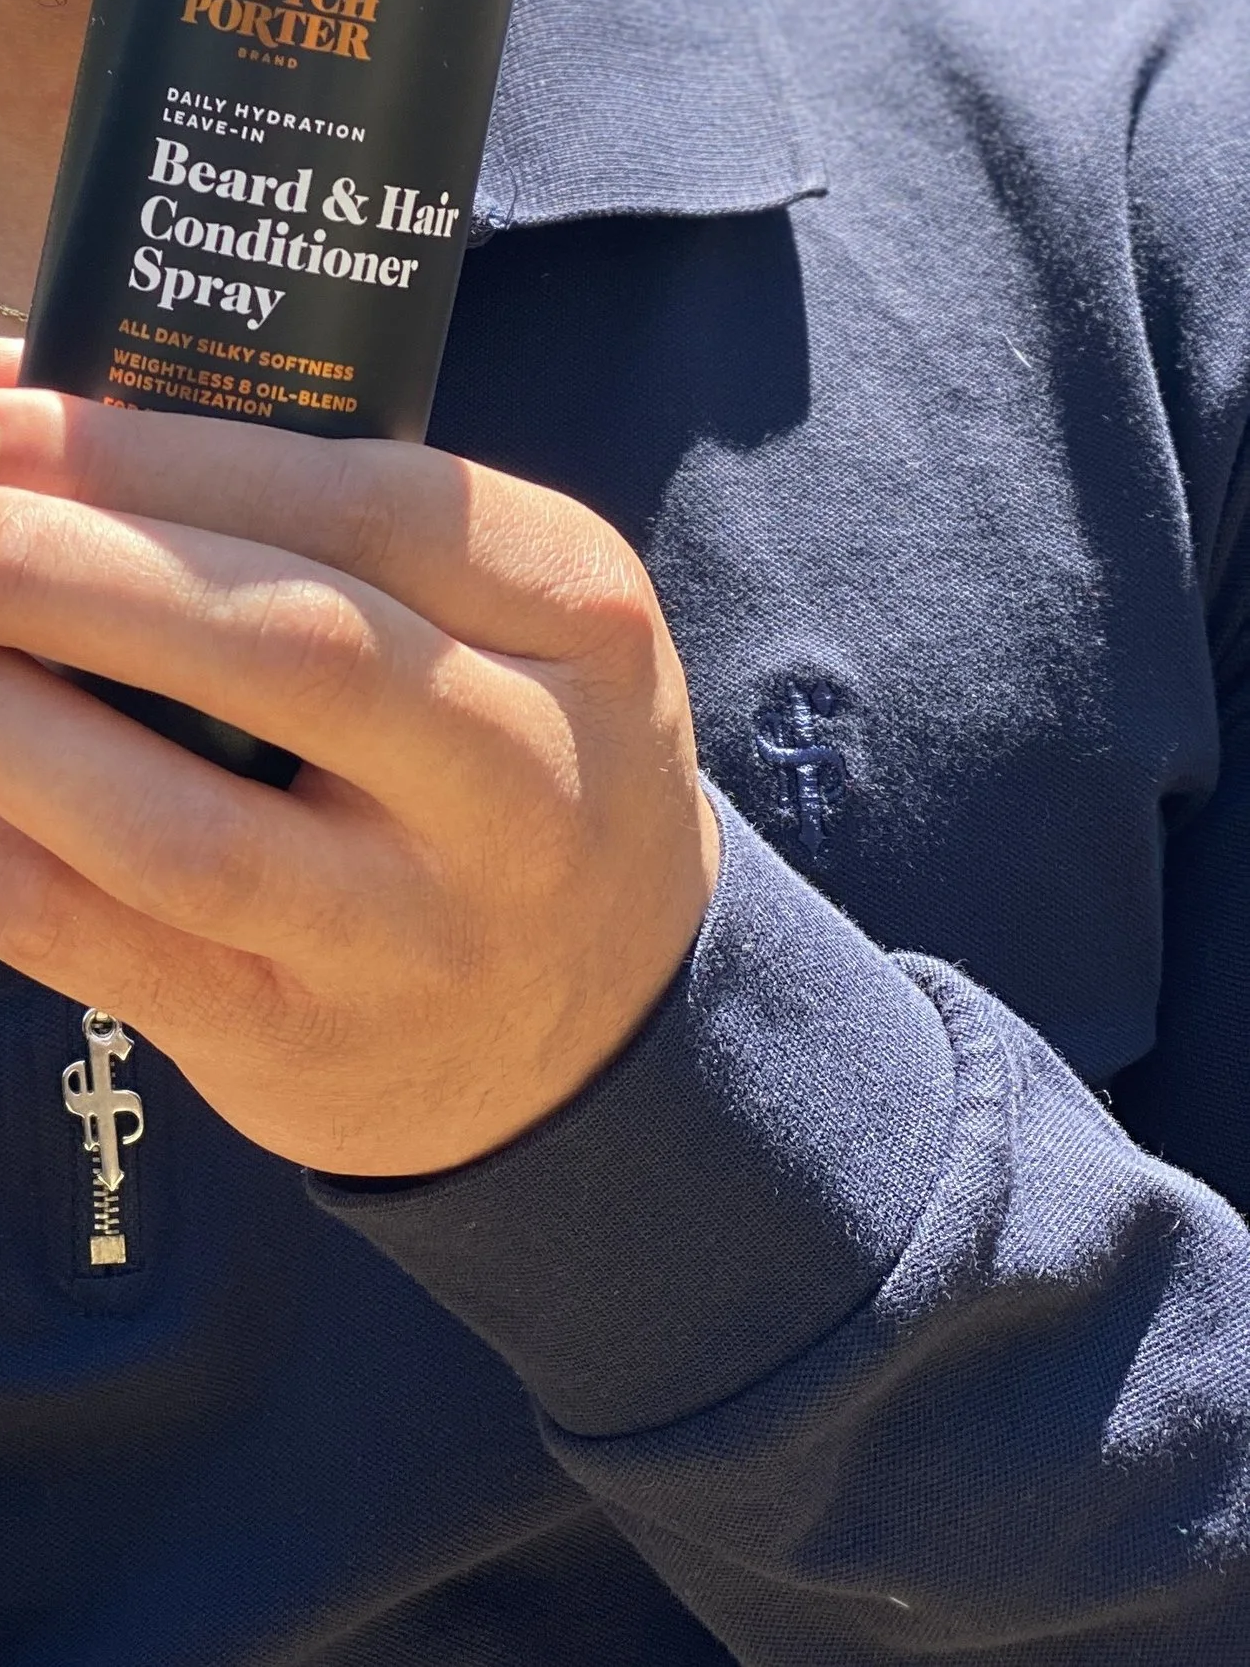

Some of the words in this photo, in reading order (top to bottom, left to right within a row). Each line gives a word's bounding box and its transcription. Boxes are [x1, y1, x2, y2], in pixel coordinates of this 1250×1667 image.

[237, 47, 298, 69] BRAND
[162, 108, 265, 143] LEAVE-IN
[167, 87, 227, 113] DAILY
[235, 103, 366, 143] HYDRATION
[148, 137, 313, 213] Beard
[322, 177, 370, 225] &
[376, 185, 460, 237] Hair
[141, 195, 418, 288] Conditioner
[129, 246, 286, 330] Spray
[113, 347, 234, 391] WEIGHTLESS
[257, 383, 358, 413] OIL-BLEND
[119, 318, 150, 340] ALL
[154, 327, 193, 349] DAY
[197, 338, 255, 364] SILKY
[258, 350, 355, 381] SOFTNESS
[109, 366, 273, 418] MOISTURIZATION
